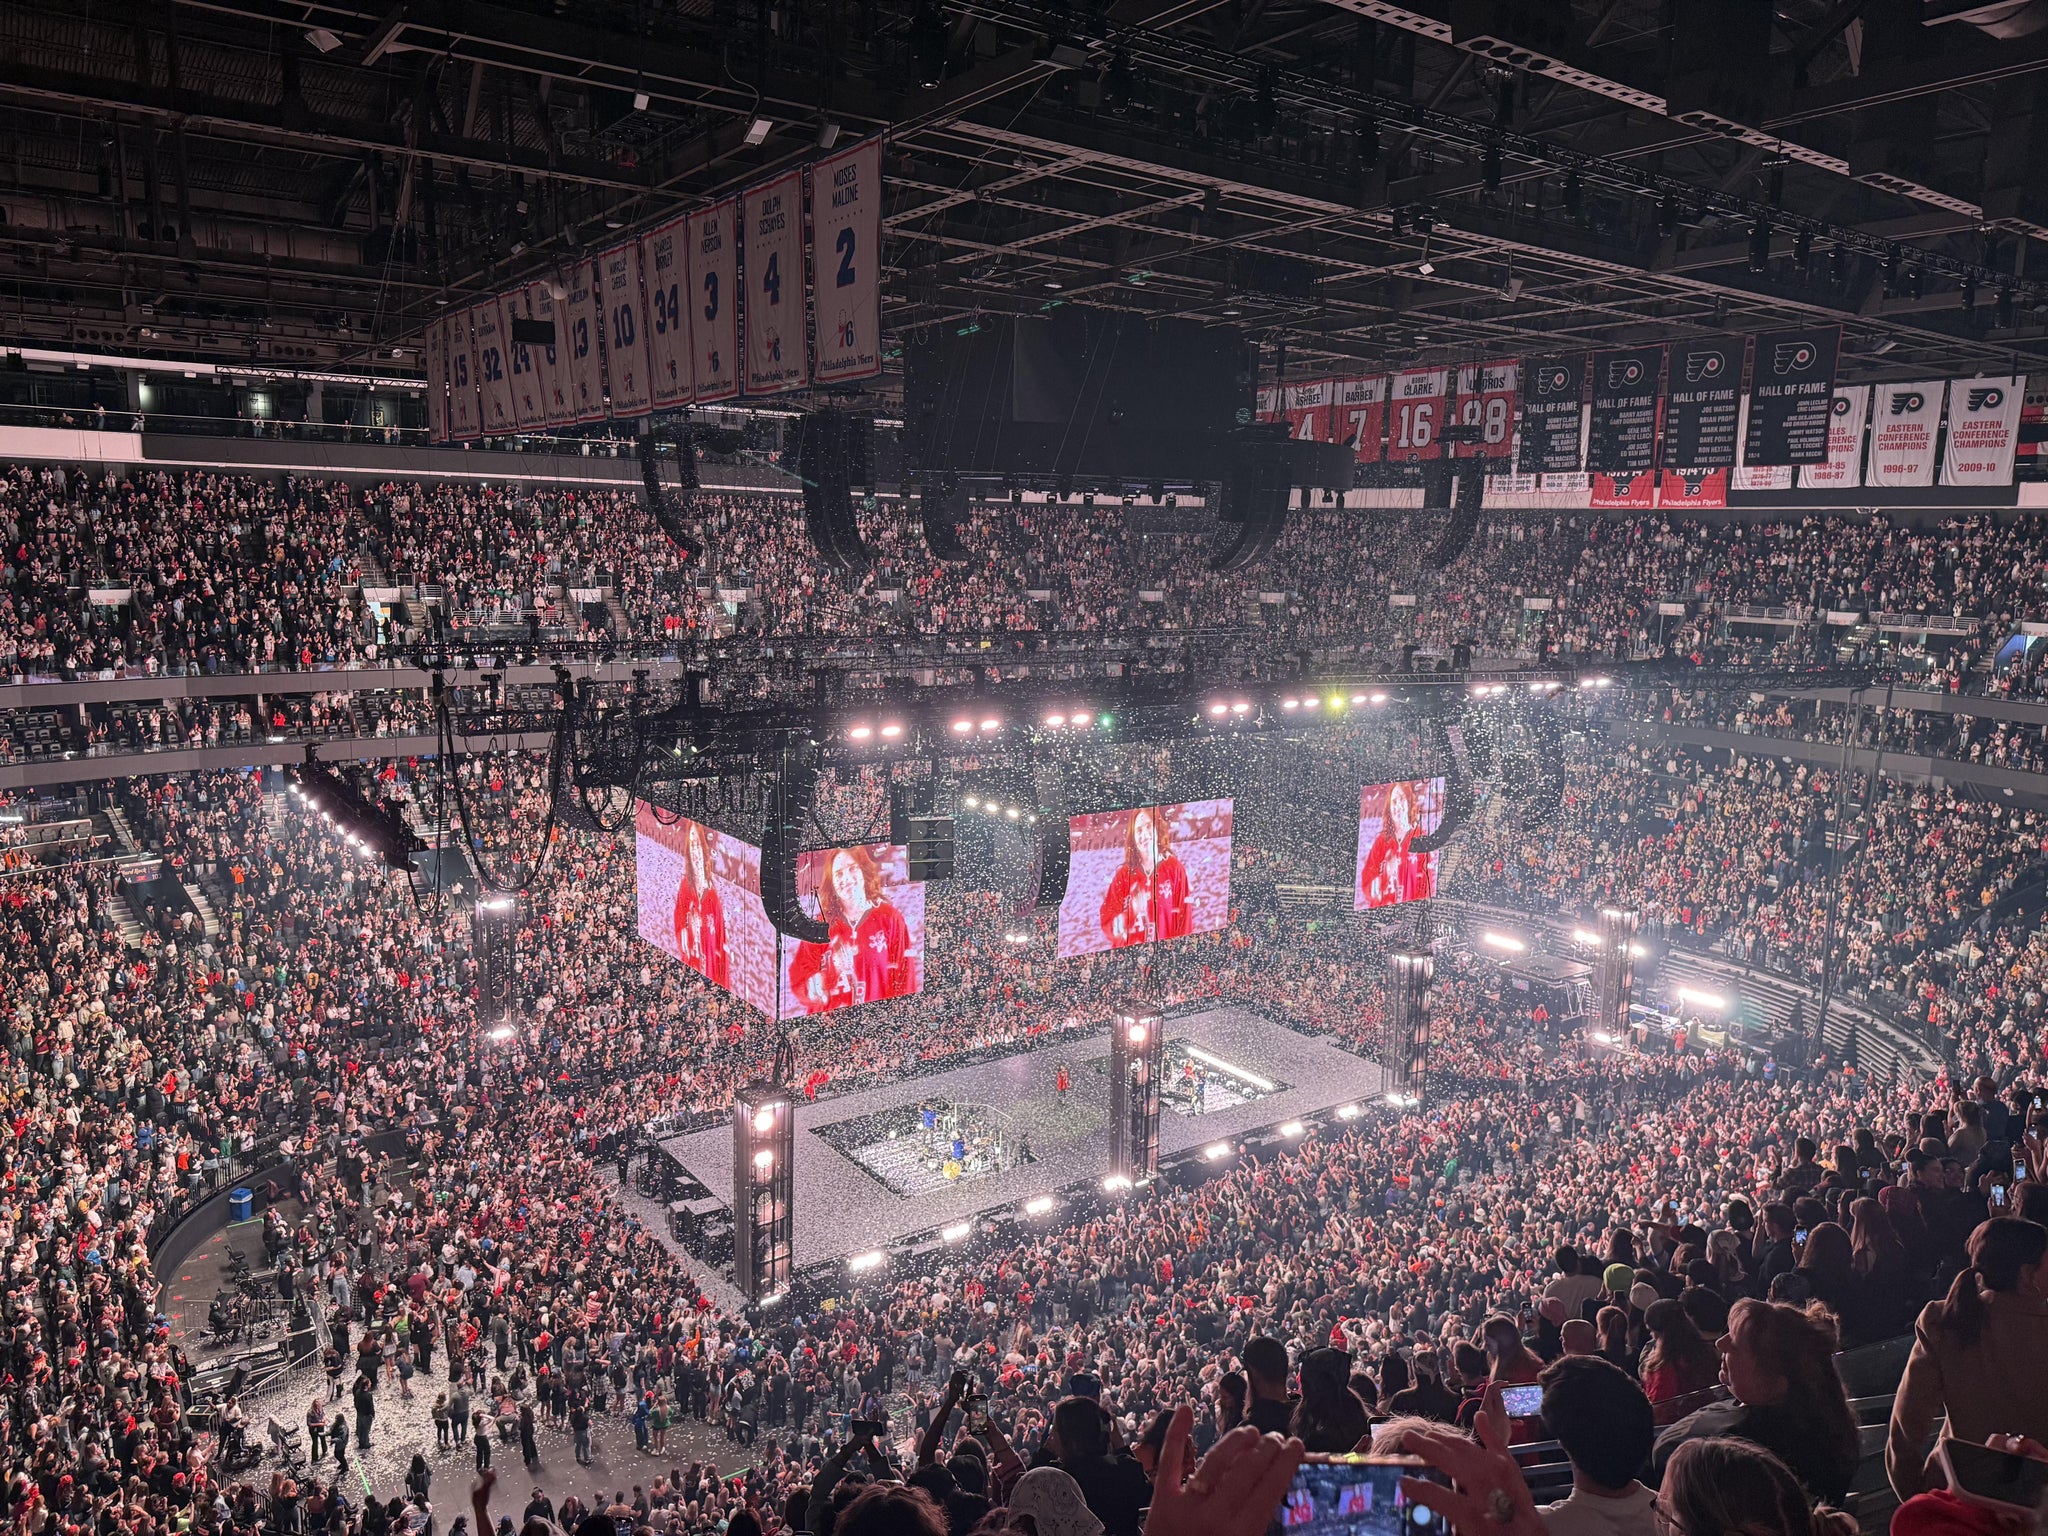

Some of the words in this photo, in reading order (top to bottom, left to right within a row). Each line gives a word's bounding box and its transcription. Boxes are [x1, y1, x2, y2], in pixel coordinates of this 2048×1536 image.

[833, 163, 857, 188] MOSES
[832, 183, 859, 209] MALONE
[762, 195, 781, 216] DOLPH
[759, 212, 785, 235] SCHAYES
[836, 227, 855, 288] 2
[764, 252, 780, 306] 4
[704, 271, 719, 321] 3
[654, 284, 678, 335] 34
[613, 304, 635, 349] 10
[572, 318, 589, 360] 13
[838, 321, 854, 347] 76
[482, 347, 503, 382] 32
[820, 358, 856, 372] Philadelphia
[857, 354, 874, 366] 76ers
[454, 354, 468, 388] 15
[1404, 383, 1433, 396] CLARKE
[1466, 377, 1505, 390] LIDROS
[1759, 385, 1782, 396] HALL
[1784, 384, 1797, 395] OF
[1798, 382, 1827, 394] FAME
[1296, 393, 1320, 406] ASHBEE
[1597, 399, 1616, 408] HALL
[1617, 398, 1629, 408] OF
[1630, 396, 1652, 407] FAME
[1673, 393, 1694, 403] HALL
[1696, 391, 1708, 402] OF
[1710, 389, 1735, 400] FAME
[1526, 404, 1544, 414] HALL
[1546, 403, 1556, 413] OF
[1557, 401, 1578, 412] FAME
[1298, 412, 1314, 440] 4
[1397, 403, 1433, 448] 16
[1462, 397, 1508, 444] 88
[1962, 420, 2002, 430] EASTERN
[1349, 409, 1368, 452] 7
[1829, 427, 1846, 435] ALES
[1887, 424, 1923, 433] EASTERN
[1953, 430, 2009, 440] CONFERENCE
[1828, 435, 1856, 444] ERENCE
[1878, 432, 1930, 442] CONFERENCE
[1827, 444, 1855, 452] MPIONS
[1879, 442, 1927, 450] CHAMPIONS
[1954, 439, 2006, 449] CHAMPIONS
[1815, 462, 1846, 470] 1984-85
[1883, 464, 1918, 473] 1996-97
[1958, 463, 1996, 472] 2009-10
[1814, 472, 1844, 480] 1986-87
[1592, 498, 1630, 507] Philadelphia
[1631, 499, 1650, 507] Flyers
[1662, 499, 1701, 507] Philadelphia
